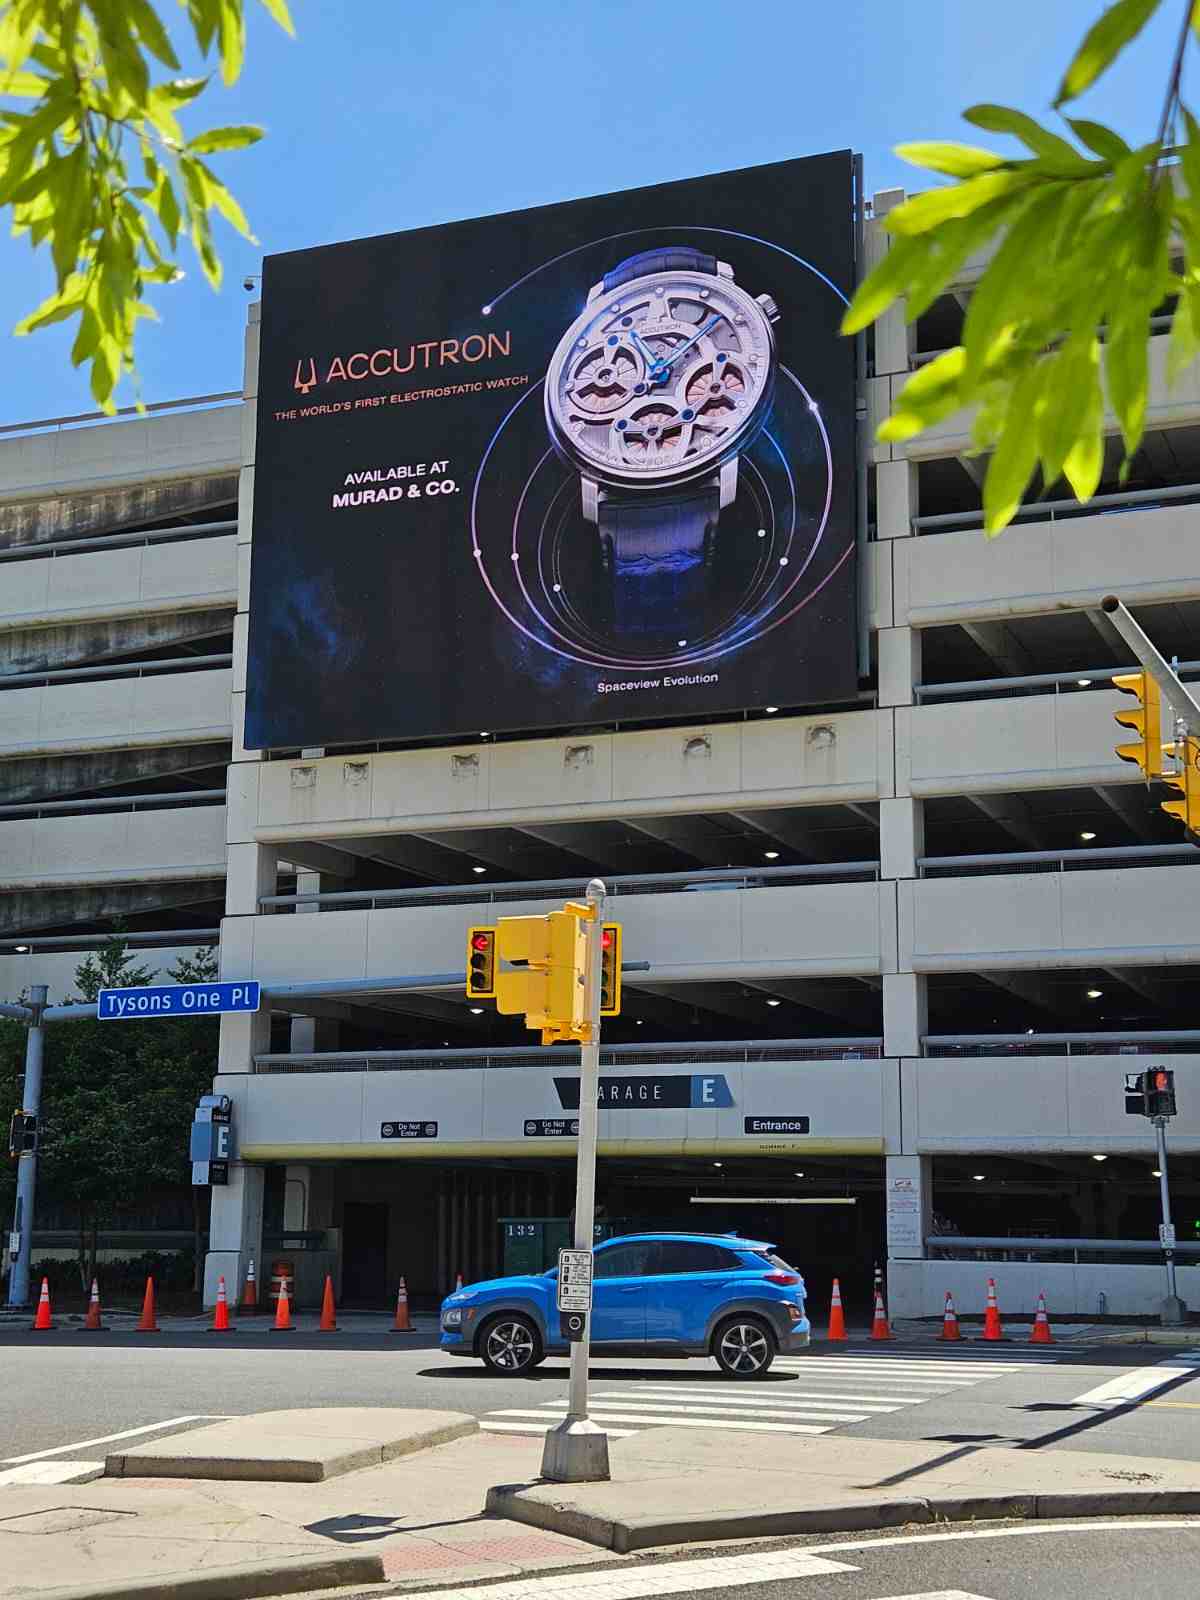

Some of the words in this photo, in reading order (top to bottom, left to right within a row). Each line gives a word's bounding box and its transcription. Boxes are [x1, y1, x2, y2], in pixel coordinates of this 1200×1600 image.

[326, 330, 511, 383] ACCUTRON
[274, 410, 297, 421] THE
[300, 401, 351, 417] WORLD'S
[354, 395, 387, 409] FIRST
[390, 381, 483, 404] ELECTROSTATIC
[486, 375, 529, 390] WATCH
[344, 463, 426, 486] AVAILABLE
[429, 460, 450, 474] AT
[332, 485, 403, 509] MURAD
[407, 483, 422, 498] &
[425, 479, 460, 496] CO.
[597, 680, 660, 694] Spaceview
[663, 673, 719, 687] Evolution
[107, 993, 172, 1016] Tysons
[182, 991, 221, 1008] One
[232, 986, 250, 1005] Pl
[597, 1085, 662, 1100] ARAGE
[702, 1079, 716, 1103] E
[752, 1120, 801, 1131] Entrance
[217, 1126, 229, 1158] E
[507, 1224, 536, 1236] 132
